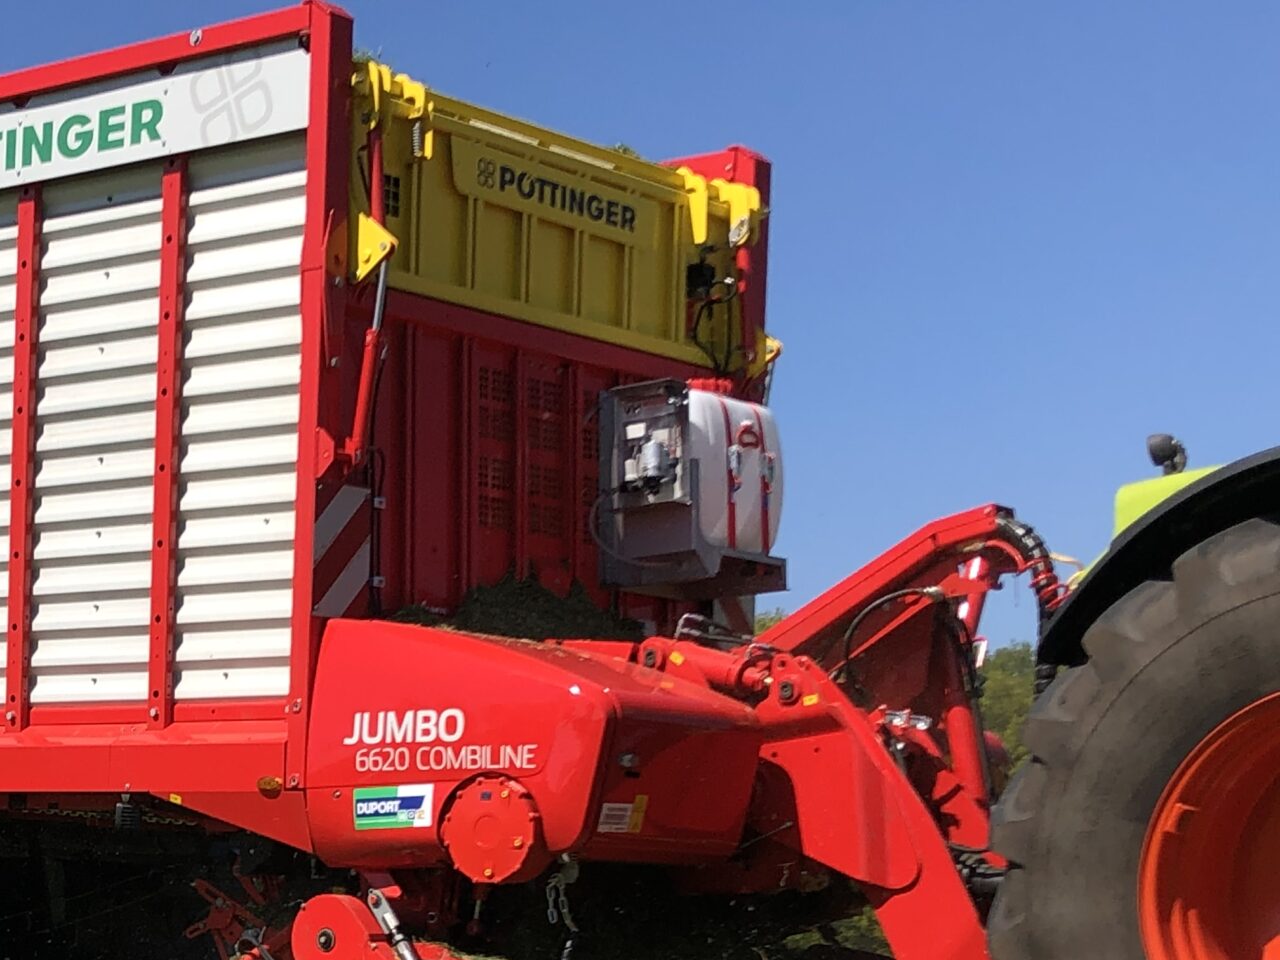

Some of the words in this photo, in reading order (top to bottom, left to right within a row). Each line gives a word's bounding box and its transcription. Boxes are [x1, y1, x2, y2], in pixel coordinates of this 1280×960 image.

[499, 166, 636, 232] PÖTTINGER
[343, 708, 465, 745] JUMBO
[354, 747, 410, 773] 6620
[416, 744, 538, 771] COMBILINE
[356, 800, 401, 815] DUPORT
